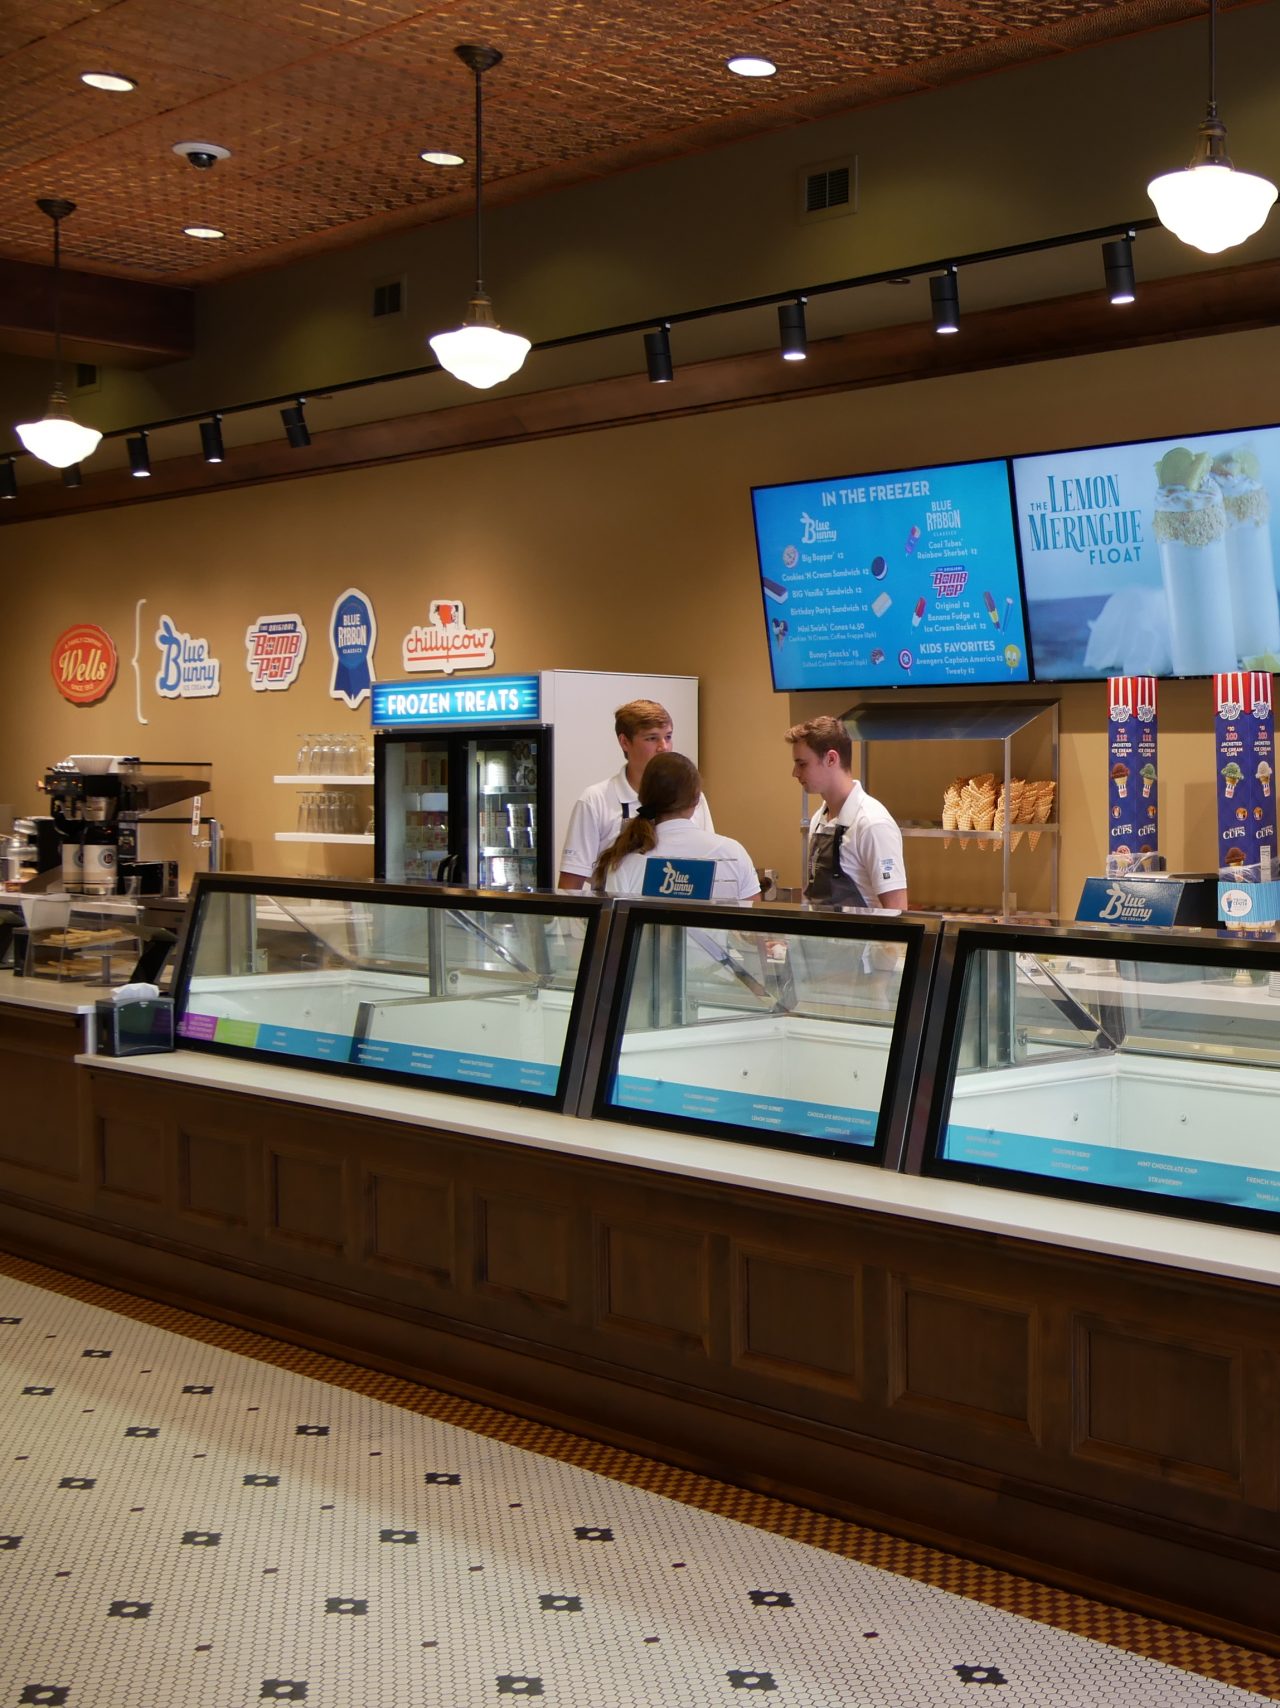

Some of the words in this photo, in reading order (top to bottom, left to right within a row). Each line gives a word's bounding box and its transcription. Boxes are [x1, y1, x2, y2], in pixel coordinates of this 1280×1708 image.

[821, 490, 837, 506] IN
[838, 486, 866, 505] THE
[868, 479, 930, 501] FREEZER
[1047, 474, 1120, 513] LEMON
[930, 499, 952, 511] BLUE
[1030, 501, 1047, 511] THE
[925, 508, 961, 531] RIBBON
[1028, 509, 1144, 552] MERINGUE
[1089, 546, 1141, 565] FLOAT
[343, 614, 361, 626] BLUE
[252, 632, 300, 656] BOMB
[338, 625, 367, 648] RIBBON
[918, 642, 942, 654] KIDS
[943, 639, 996, 653] FAVORITES
[59, 649, 107, 682] Wells
[255, 656, 294, 681] POP
[387, 691, 450, 716] FROZEN
[455, 688, 519, 712] TREATS
